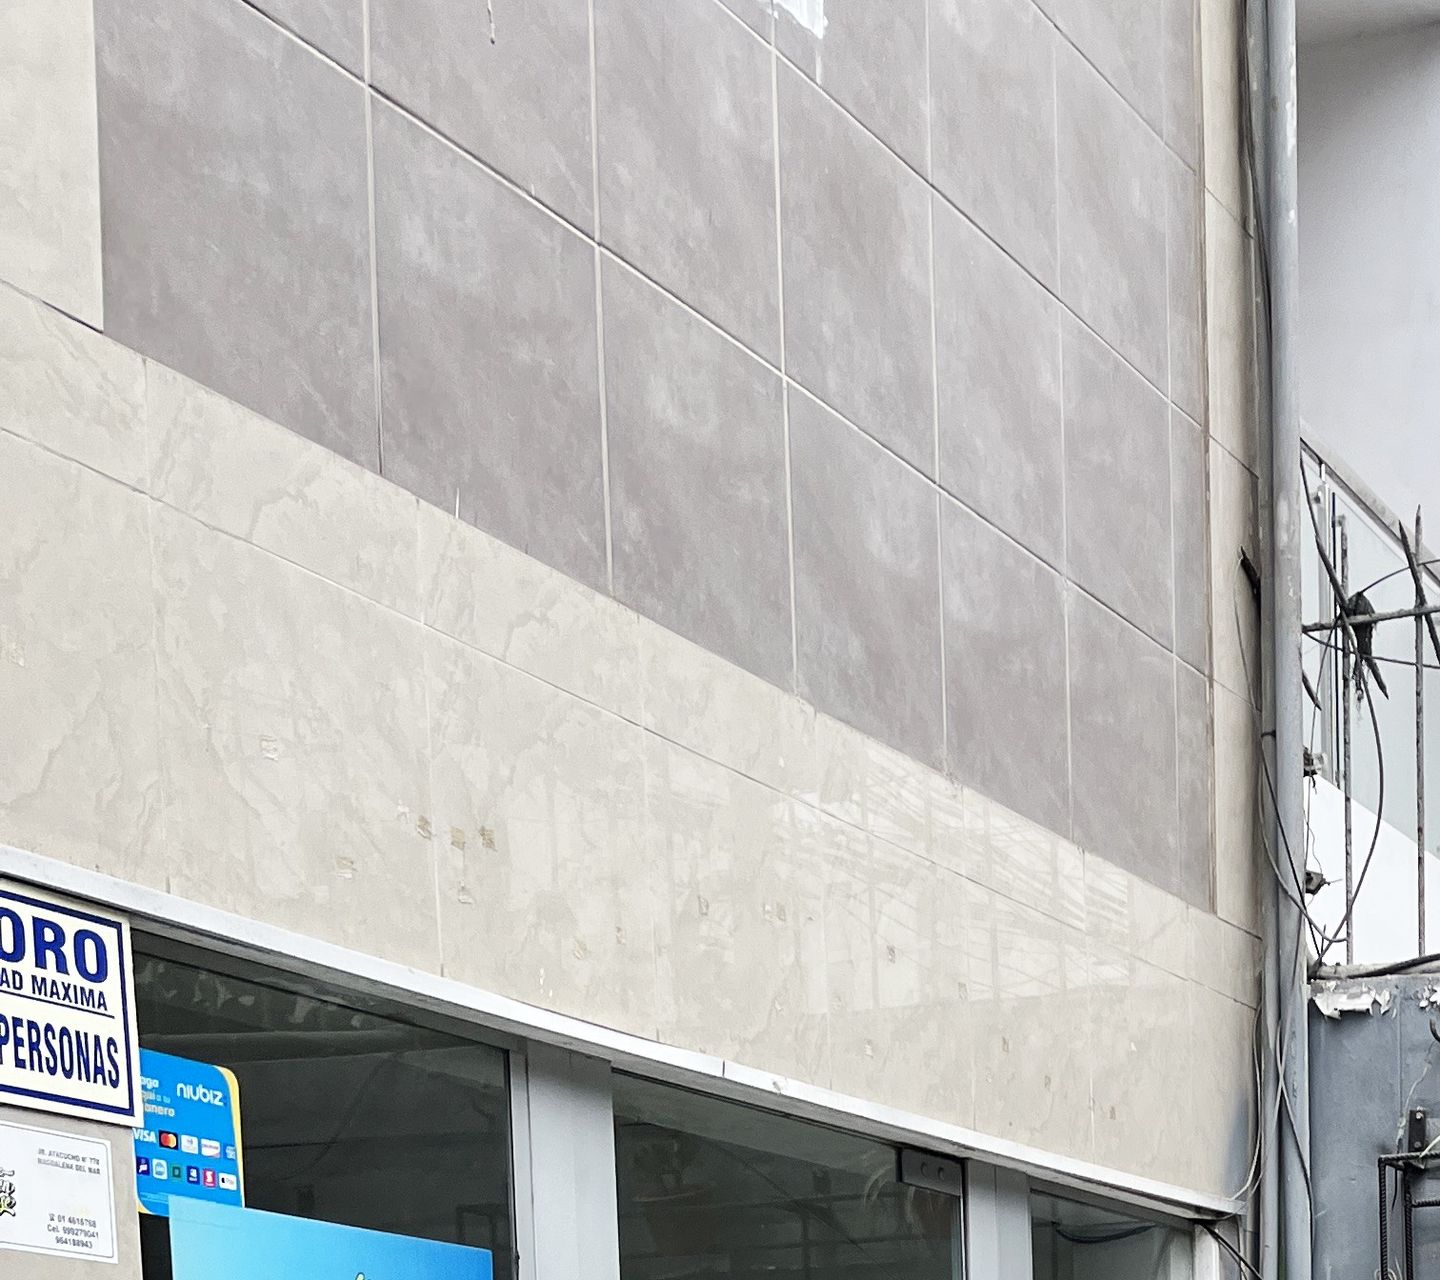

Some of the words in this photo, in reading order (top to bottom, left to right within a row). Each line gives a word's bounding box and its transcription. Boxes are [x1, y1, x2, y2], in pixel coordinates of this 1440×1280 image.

[31, 974, 108, 1011] MAXIMA
[0, 1013, 120, 1089] PERSONAS
[132, 1127, 157, 1144] VISA
